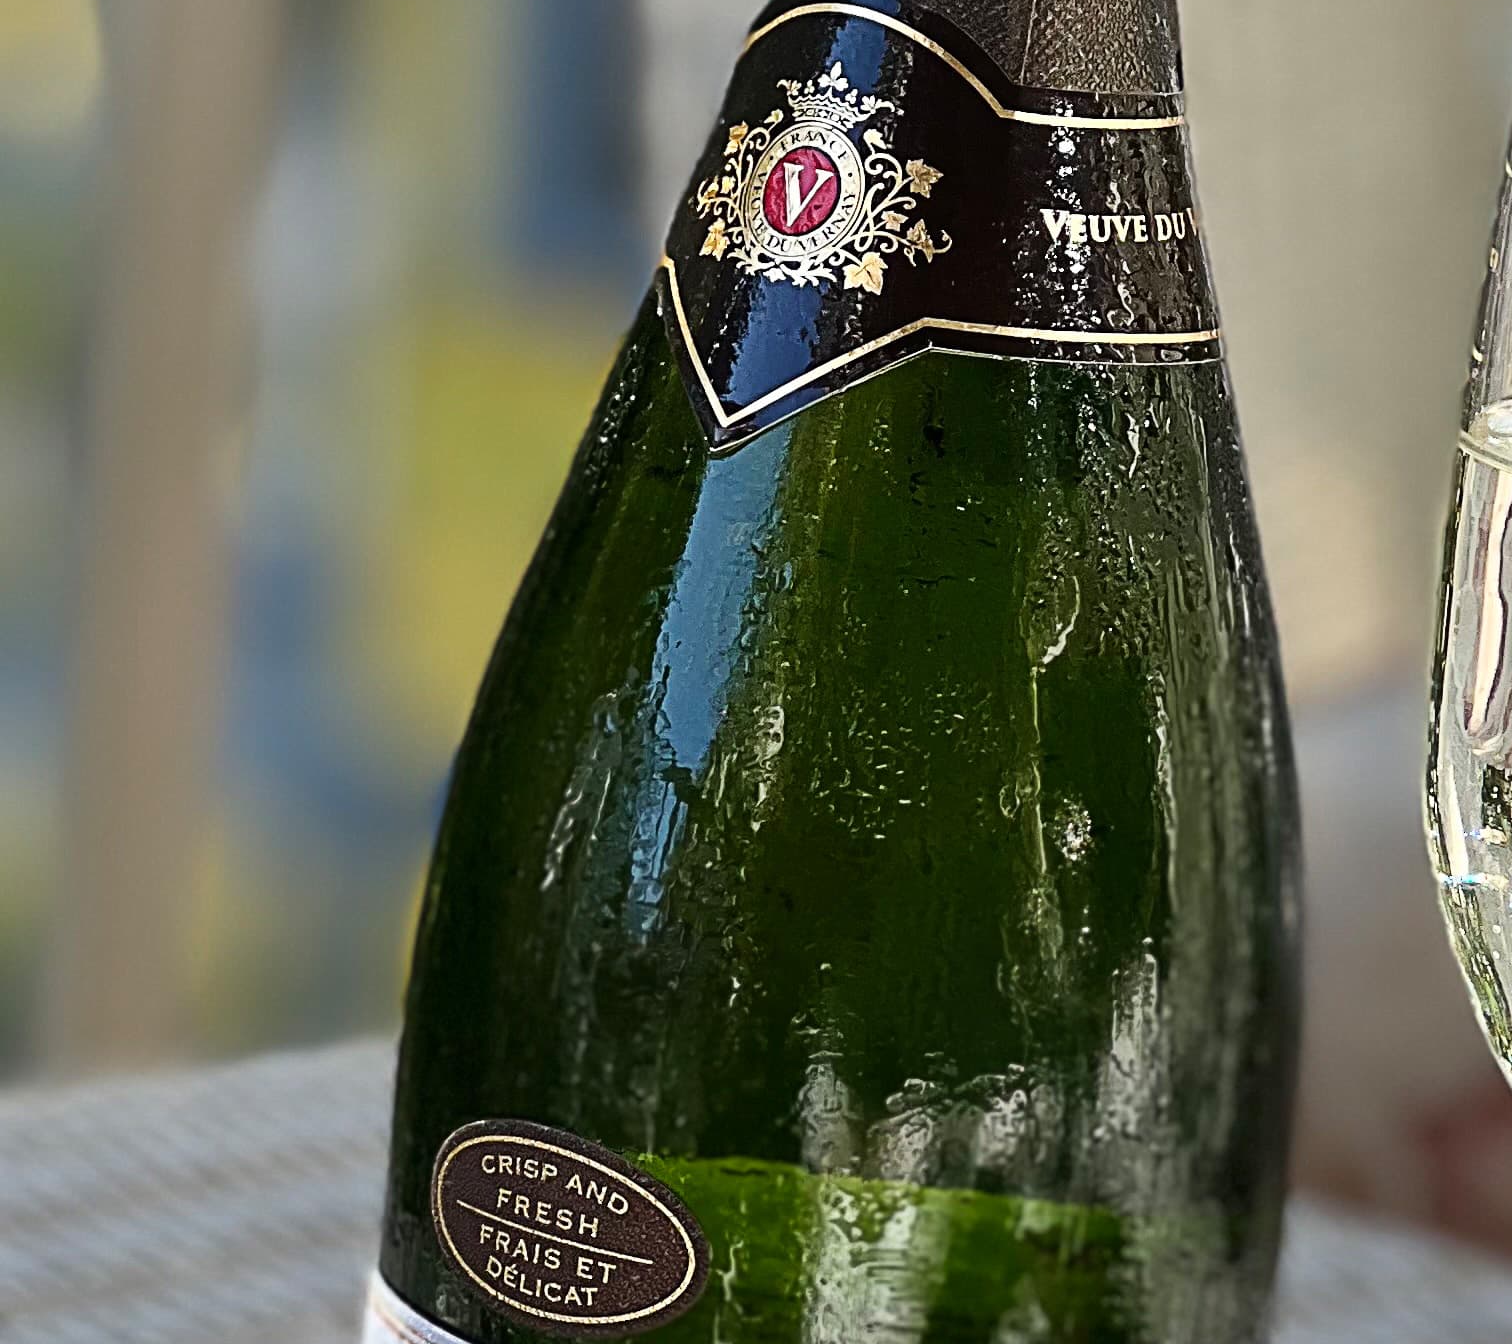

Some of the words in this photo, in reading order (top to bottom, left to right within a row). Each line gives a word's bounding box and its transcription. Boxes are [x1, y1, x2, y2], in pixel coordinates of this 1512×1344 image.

[783, 162, 834, 227] V
[1040, 208, 1149, 243] VEUVE
[1154, 212, 1186, 241] DU
[481, 1155, 559, 1182] CRISP
[565, 1173, 630, 1216] AND
[496, 1188, 600, 1239] FRESH
[479, 1223, 562, 1270] FRAIS
[576, 1257, 617, 1284] ET
[485, 1255, 598, 1306] DÉLICAT
